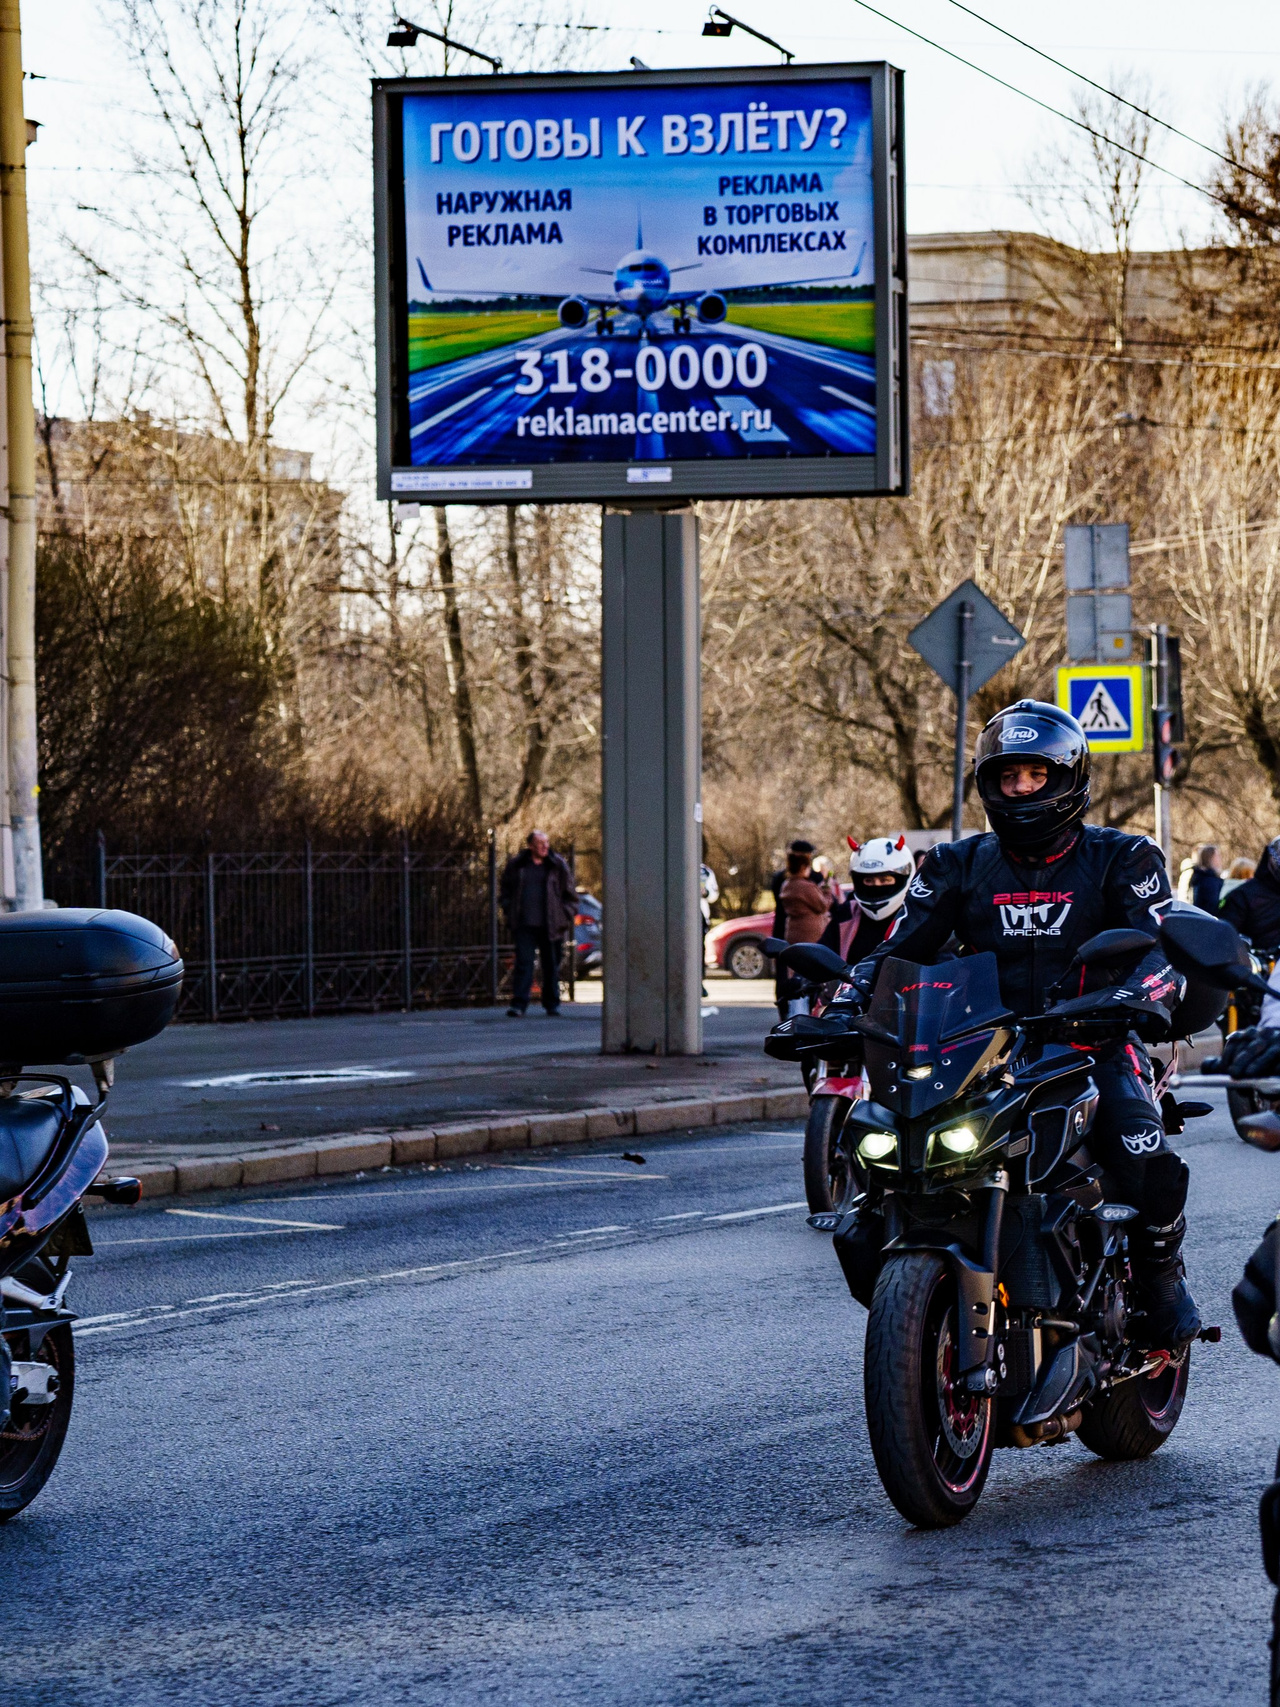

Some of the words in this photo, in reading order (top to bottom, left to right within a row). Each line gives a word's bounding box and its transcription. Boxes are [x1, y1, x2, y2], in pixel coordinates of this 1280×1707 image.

[430, 117, 602, 164] ГОТОВЫ
[618, 116, 647, 156] К
[662, 102, 849, 155] ВЗЛЁТУ?
[719, 172, 824, 197] РЕКЛАМА
[436, 188, 573, 216] НАРУЖНАЯ
[704, 206, 718, 226] В
[727, 201, 840, 225] ТОРГОВЫХ
[447, 221, 564, 247] РЕКЛАМА
[697, 230, 847, 256] КОМПЛЕКСАХ
[514, 343, 769, 395] 318-0000
[516, 407, 773, 437] reklamacenter.ru
[1001, 728, 1033, 740] Arai
[992, 891, 1075, 905] BERIK
[1003, 928, 1062, 937] RACING
[901, 982, 954, 994] MT-10
